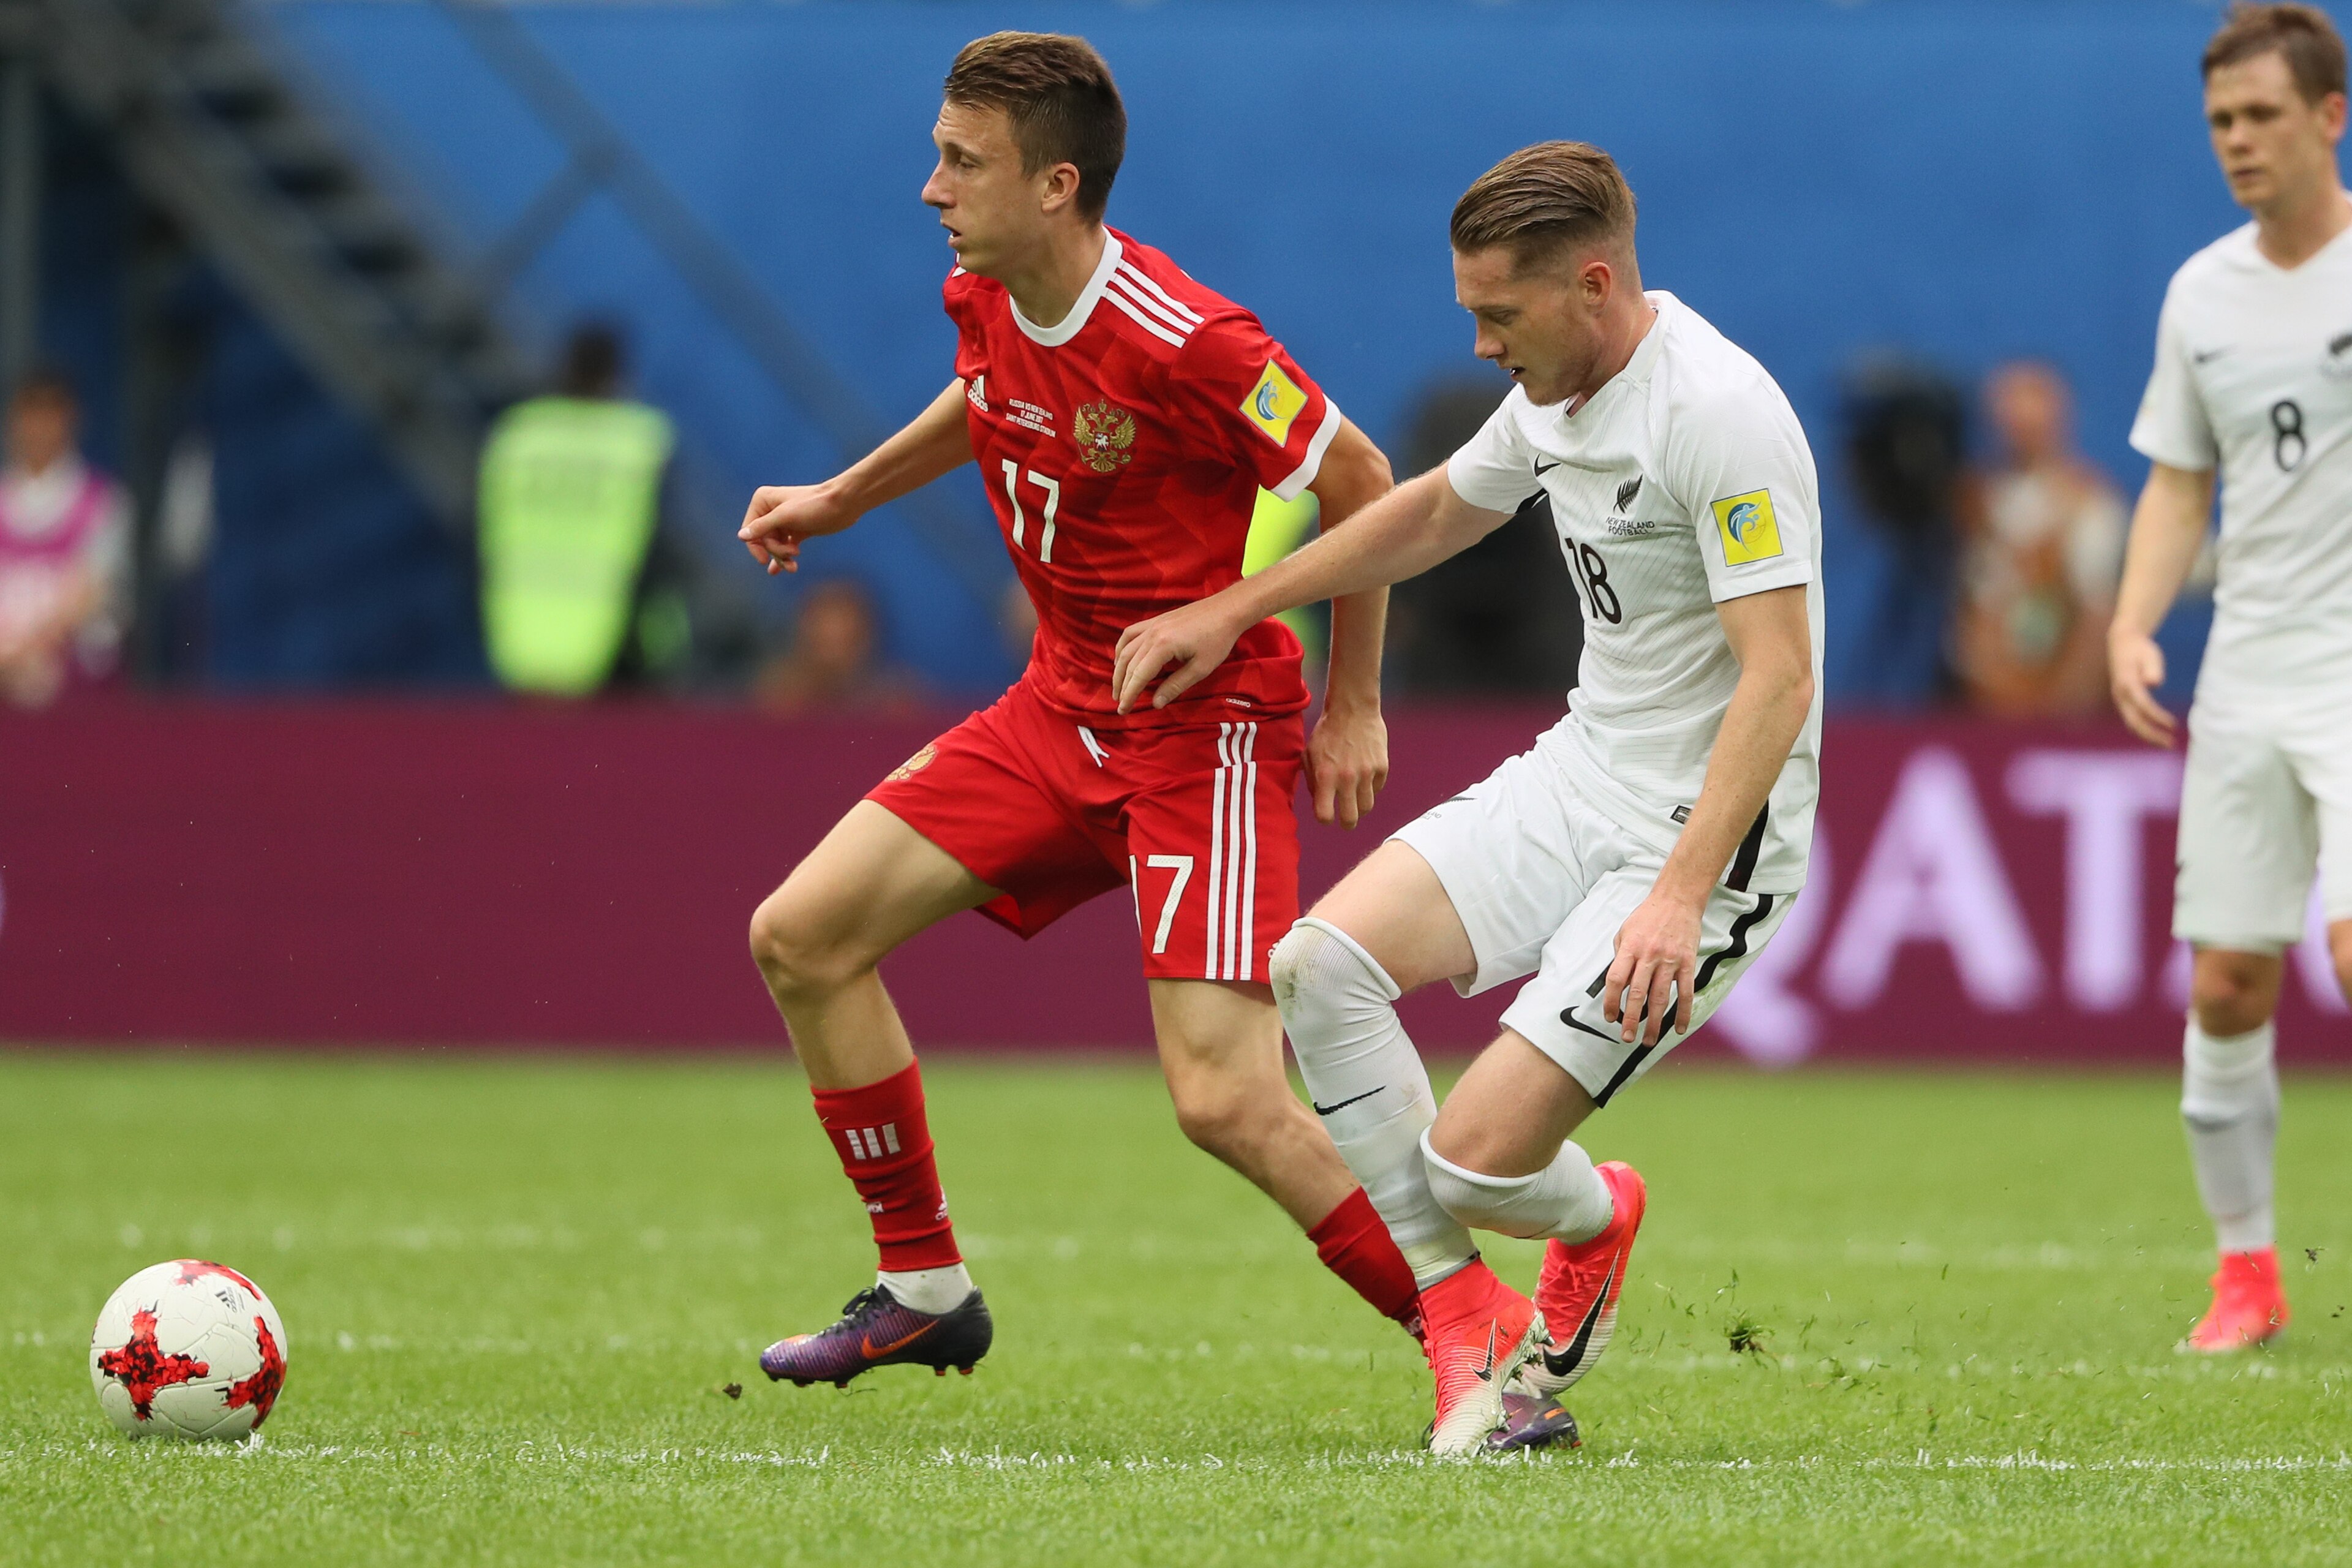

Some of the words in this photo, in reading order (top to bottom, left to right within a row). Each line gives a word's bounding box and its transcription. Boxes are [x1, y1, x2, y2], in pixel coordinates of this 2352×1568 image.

[967, 388, 989, 412] adidas
[2271, 398, 2307, 472] 8
[1001, 458, 1060, 564] 17
[1608, 526, 1653, 536] FOOTBALL
[1619, 520, 1655, 529] ZEALAND
[1564, 537, 1622, 624] 18
